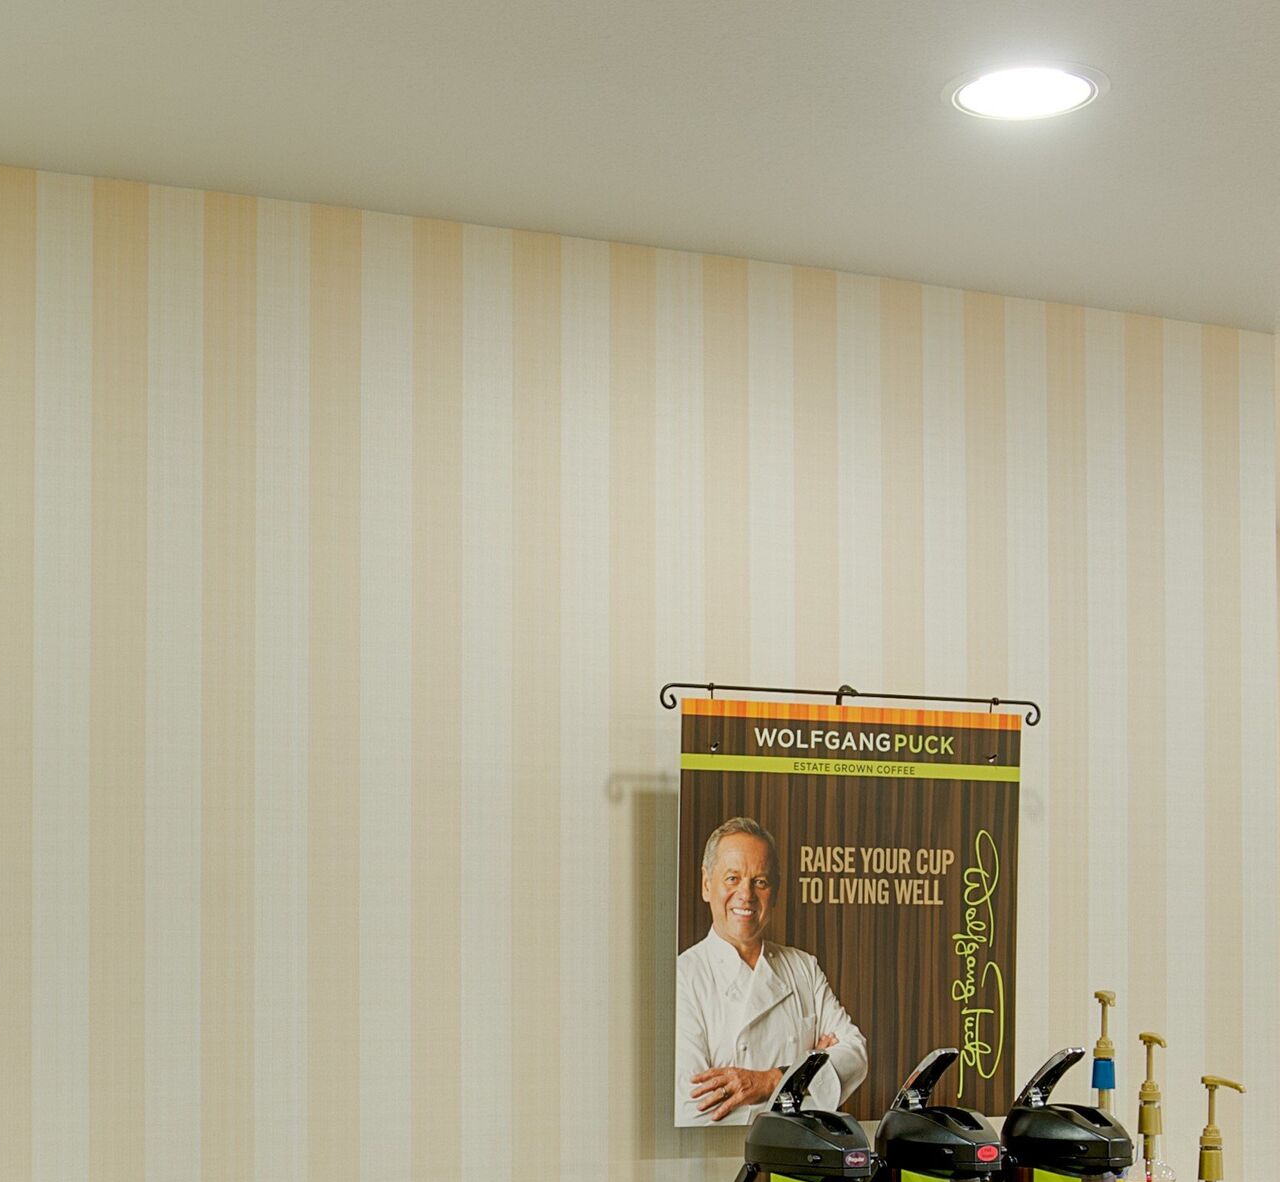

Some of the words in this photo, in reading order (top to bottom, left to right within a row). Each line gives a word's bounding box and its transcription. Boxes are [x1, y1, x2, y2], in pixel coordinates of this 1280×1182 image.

[793, 761, 831, 773] ESTATE
[834, 763, 873, 774] GROWN
[876, 765, 916, 776] COFFEE
[800, 845, 856, 873] RAISE
[860, 847, 911, 874] YOUR
[916, 848, 955, 875] CUP
[799, 877, 823, 904] TO
[828, 878, 890, 905] LIVING
[894, 879, 944, 906] WELL
